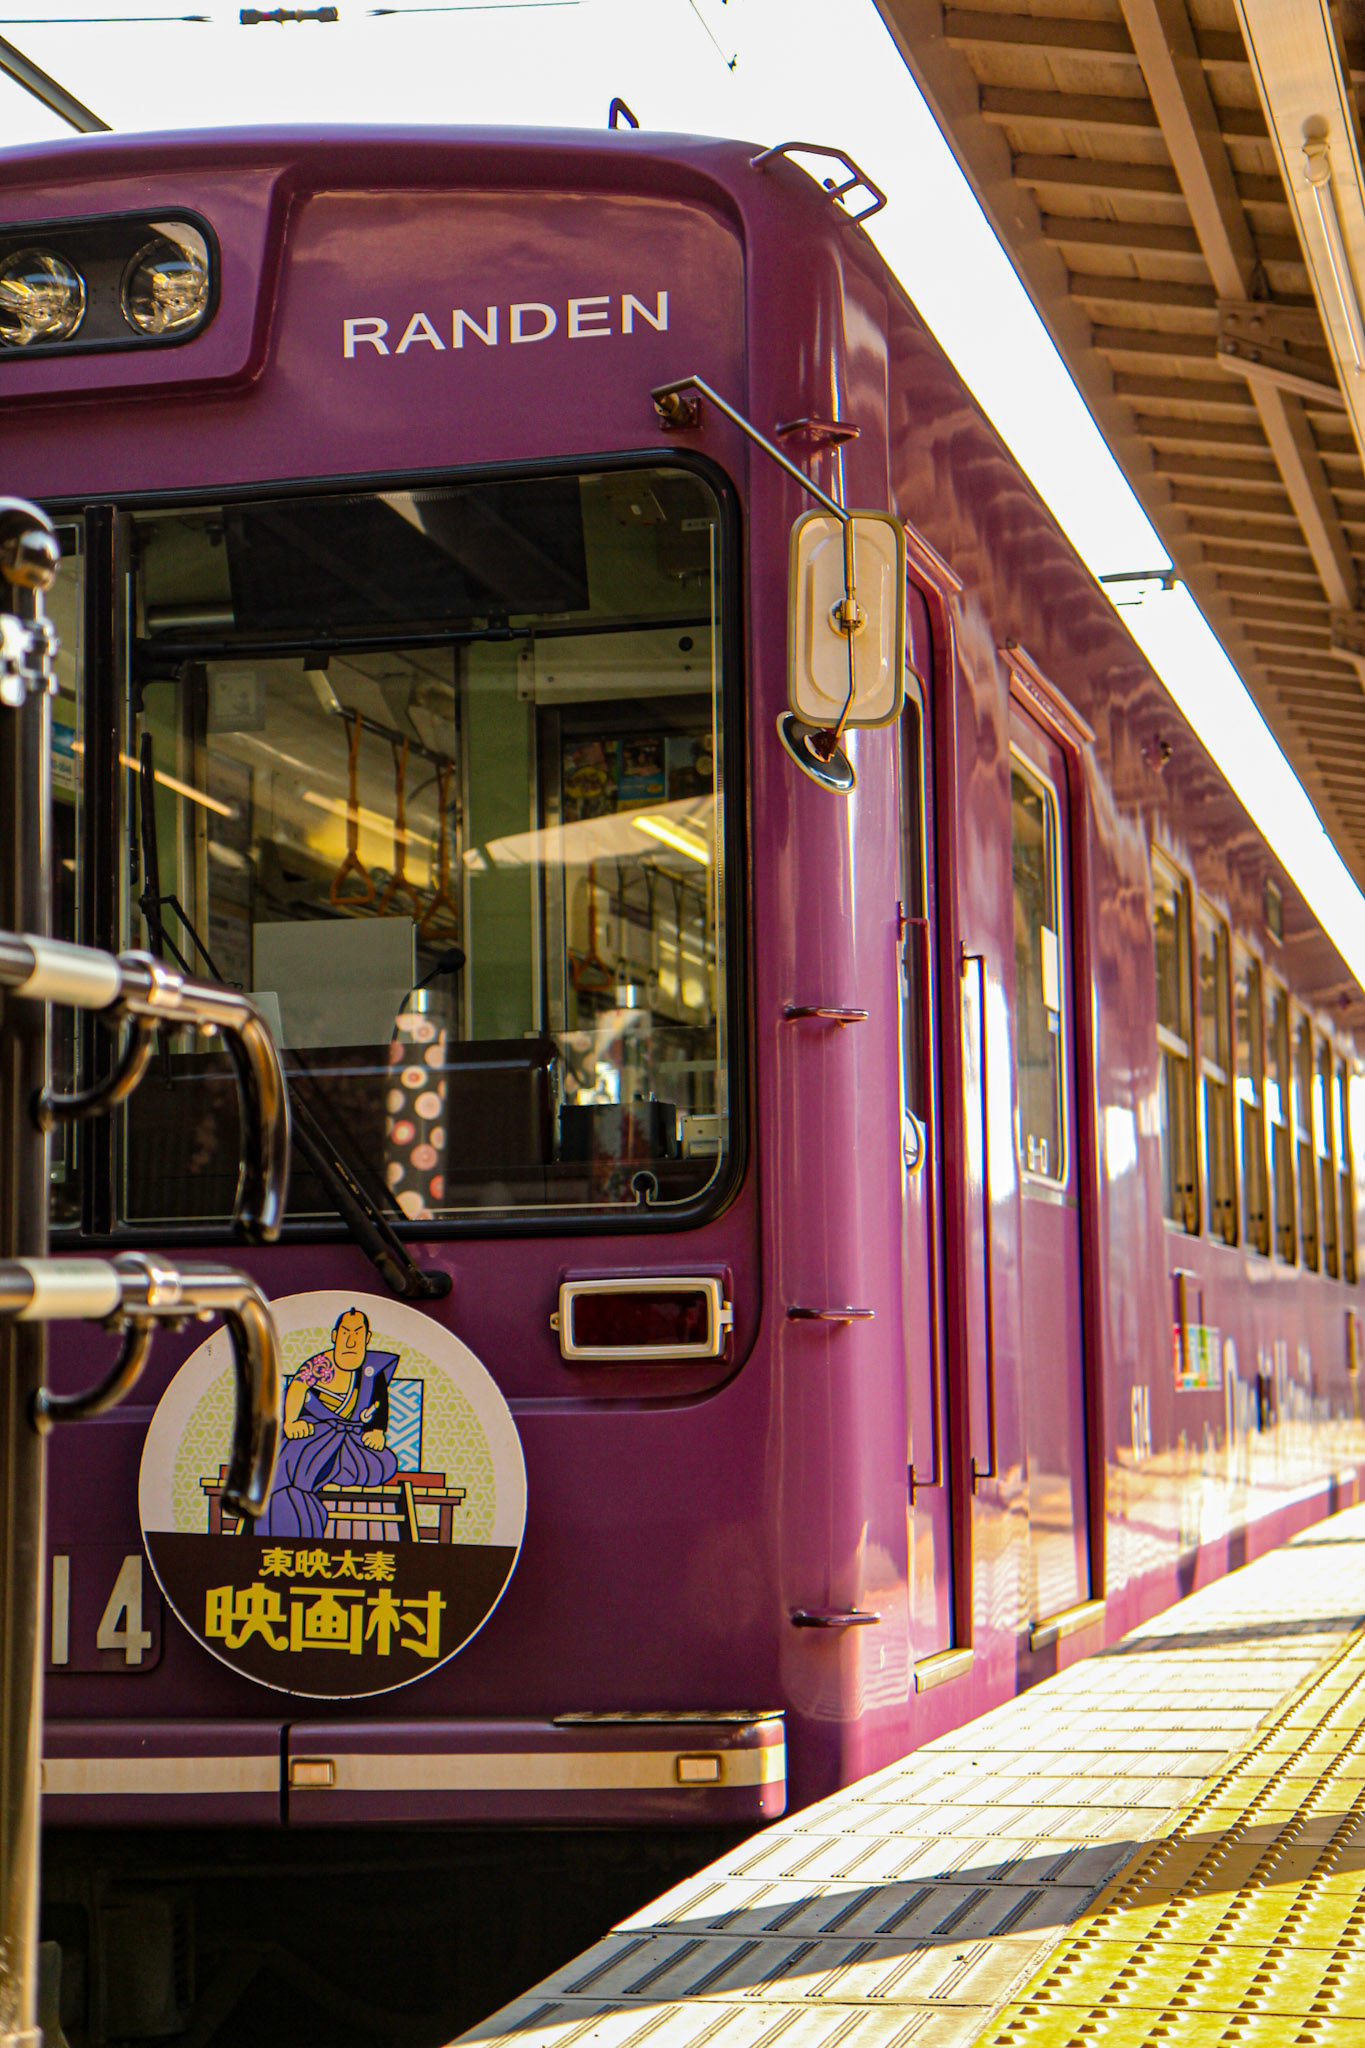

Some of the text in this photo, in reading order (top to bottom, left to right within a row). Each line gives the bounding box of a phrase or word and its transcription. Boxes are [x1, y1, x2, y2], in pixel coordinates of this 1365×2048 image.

[343, 291, 669, 358] RANDEN
[258, 1547, 396, 1582] 東映太秦
[204, 1582, 448, 1658] 映画村
